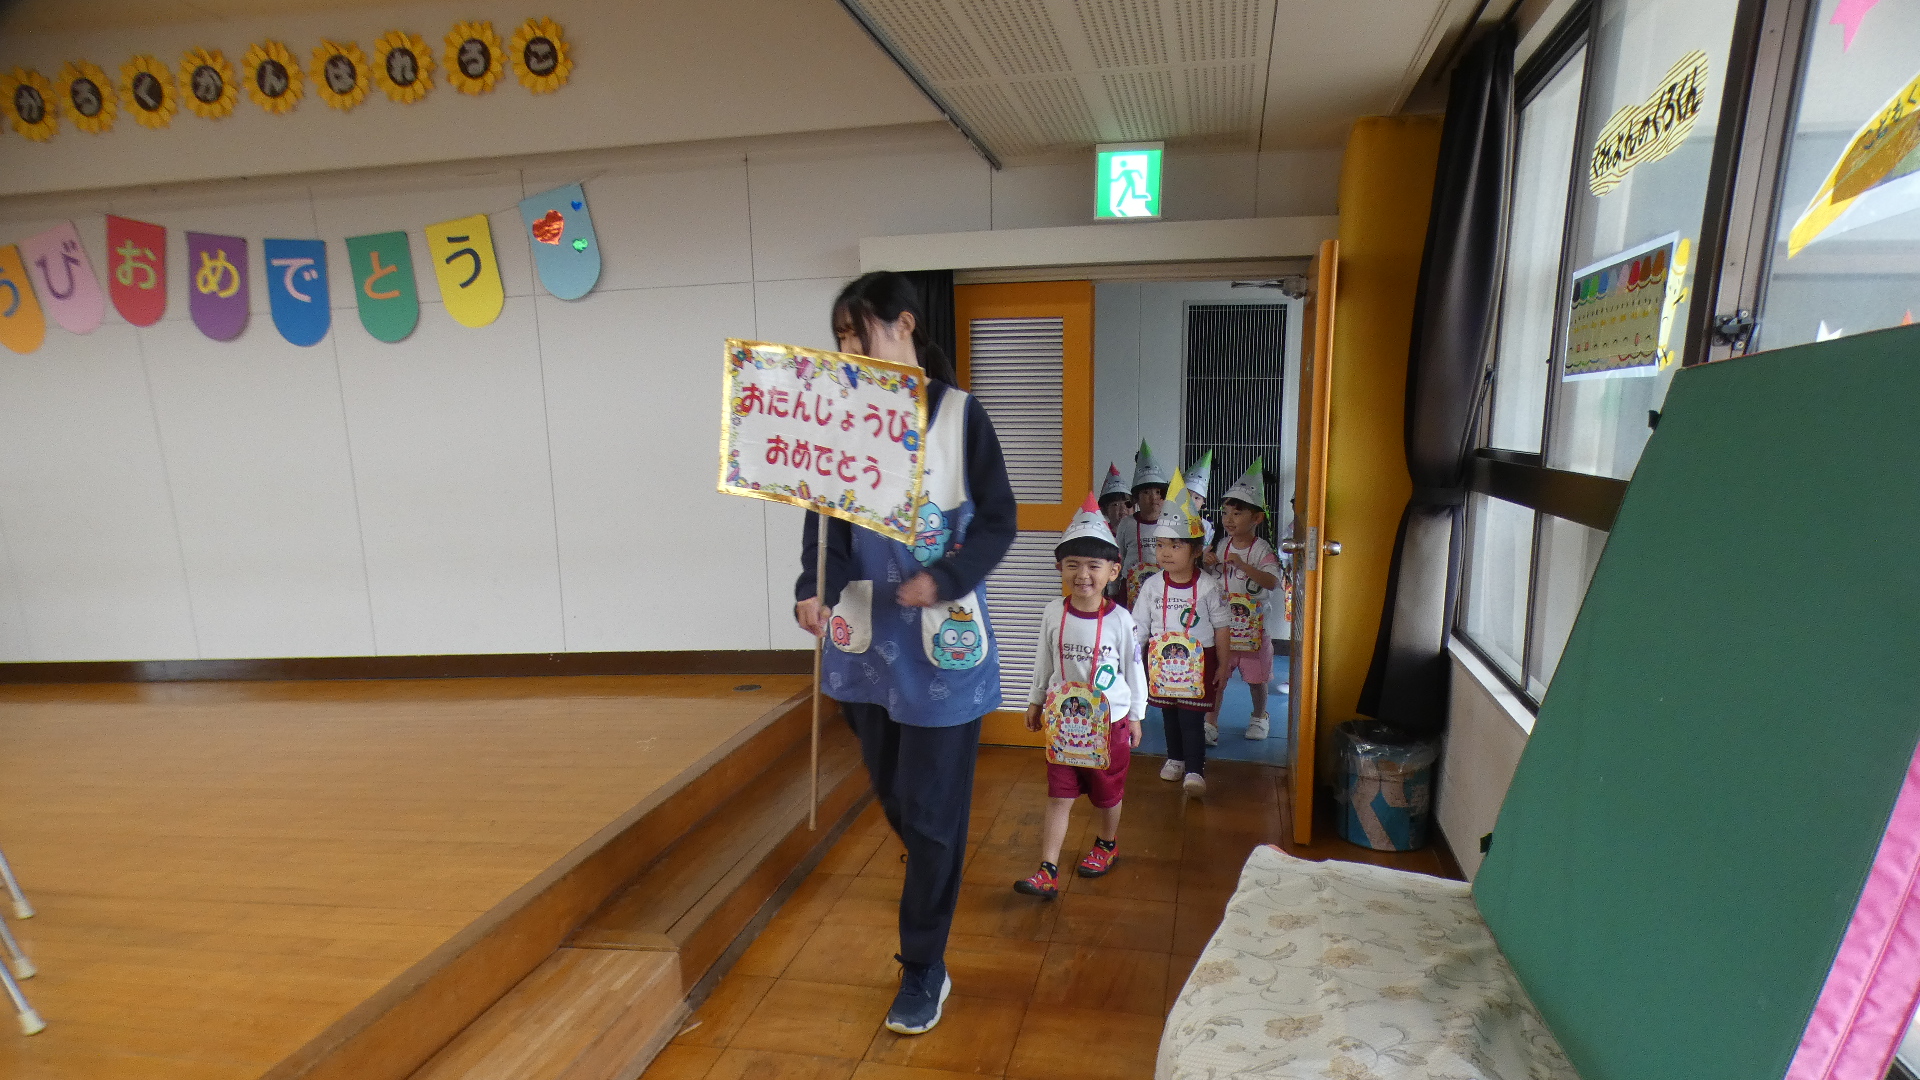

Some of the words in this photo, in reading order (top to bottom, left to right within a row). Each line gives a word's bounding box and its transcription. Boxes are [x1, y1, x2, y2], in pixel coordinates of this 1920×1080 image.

[741, 382, 912, 443] おたんじょうび
[765, 434, 882, 490] おめでとう
